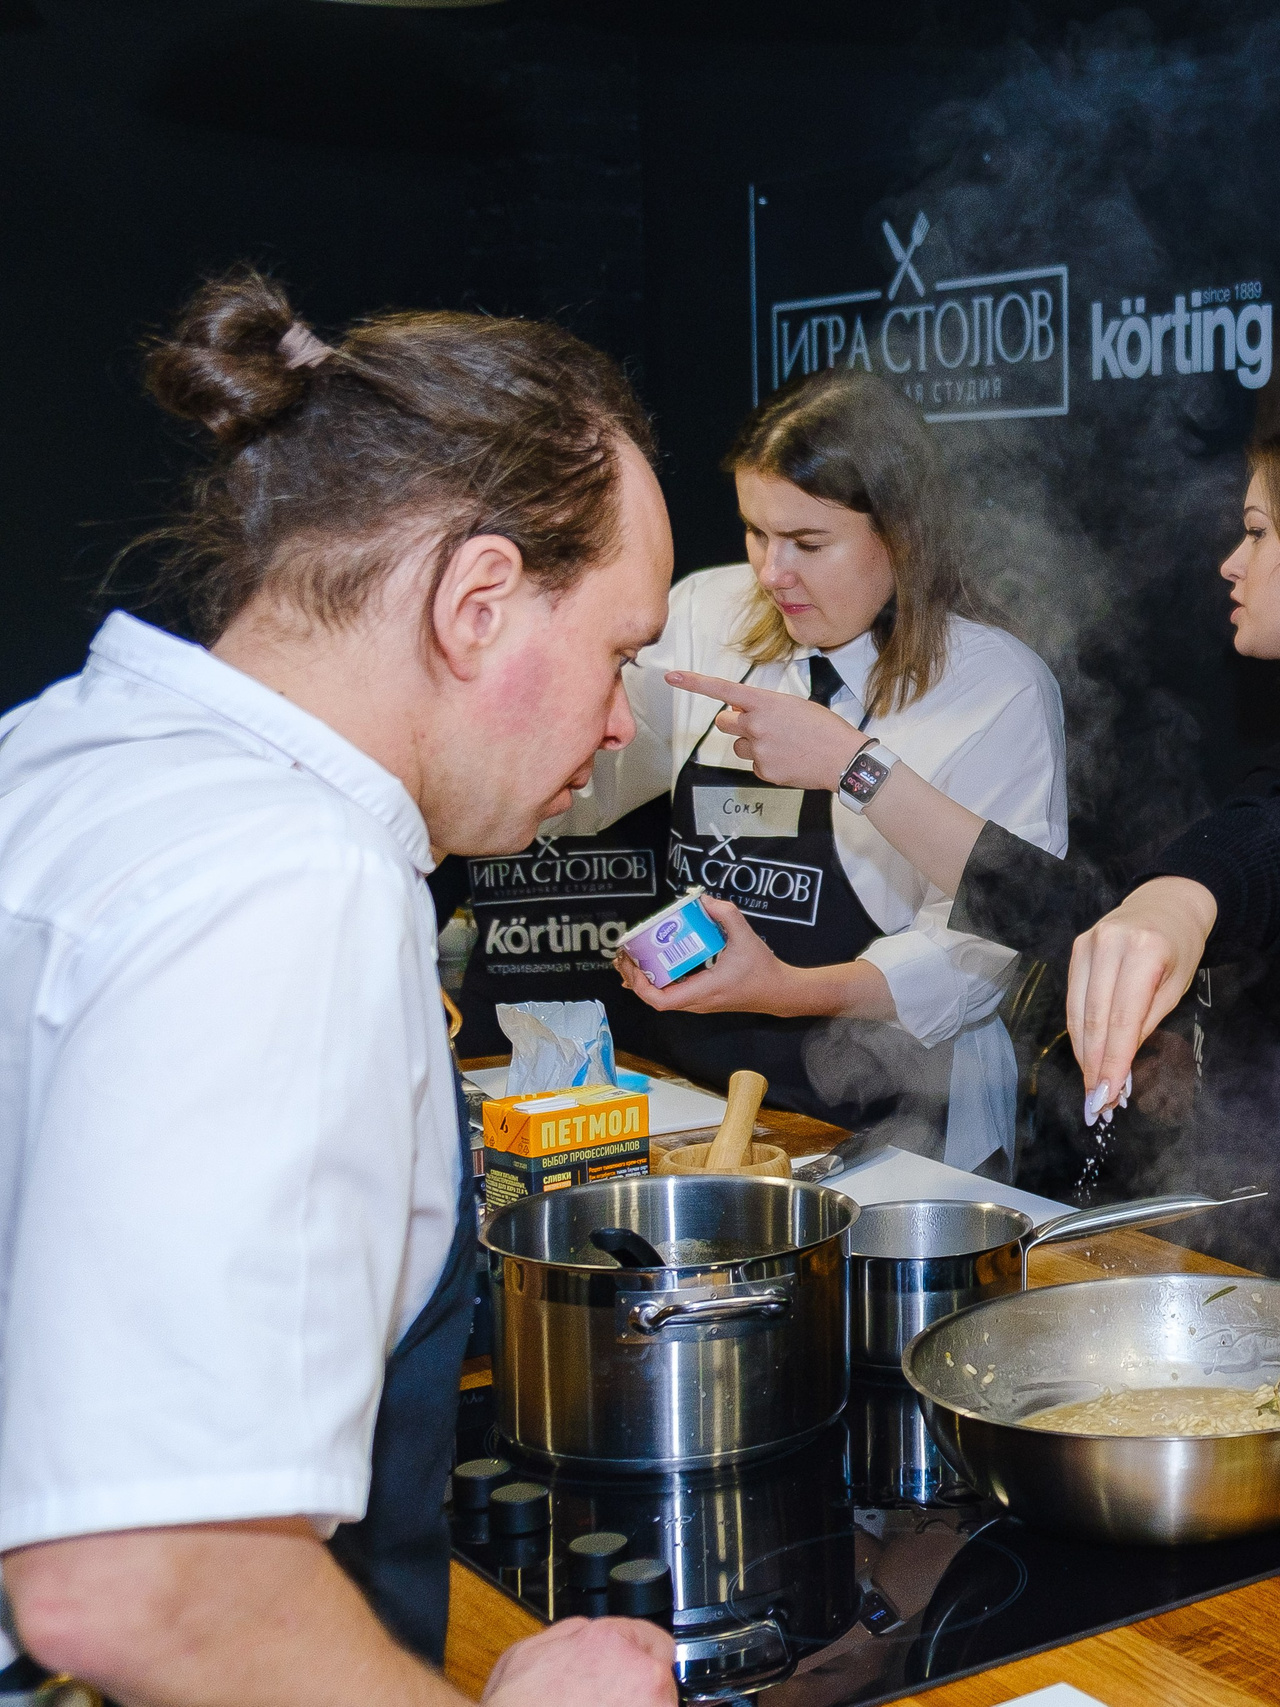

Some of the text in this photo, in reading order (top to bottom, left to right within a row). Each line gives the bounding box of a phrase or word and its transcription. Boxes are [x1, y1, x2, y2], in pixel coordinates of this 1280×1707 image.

[1201, 280, 1262, 304] since 1889
[781, 289, 1055, 381] ИГРА СТОЛОВ
[1090, 290, 1273, 390] körting
[932, 377, 1001, 403] СТУДИЯ
[473, 855, 647, 888] ИГРА СТОЛОВ
[701, 859, 811, 902] СТОЛОВ
[729, 894, 769, 910] СТУДИЯ
[485, 915, 627, 959] körting
[575, 960, 613, 972] техни
[541, 1106, 640, 1149] ПЕТМОЛ
[542, 1152, 569, 1168] ВЫБОР
[569, 1140, 640, 1163] ПРОФЕССИОНАЛОВ
[543, 1171, 572, 1185] СЛИВКИ
